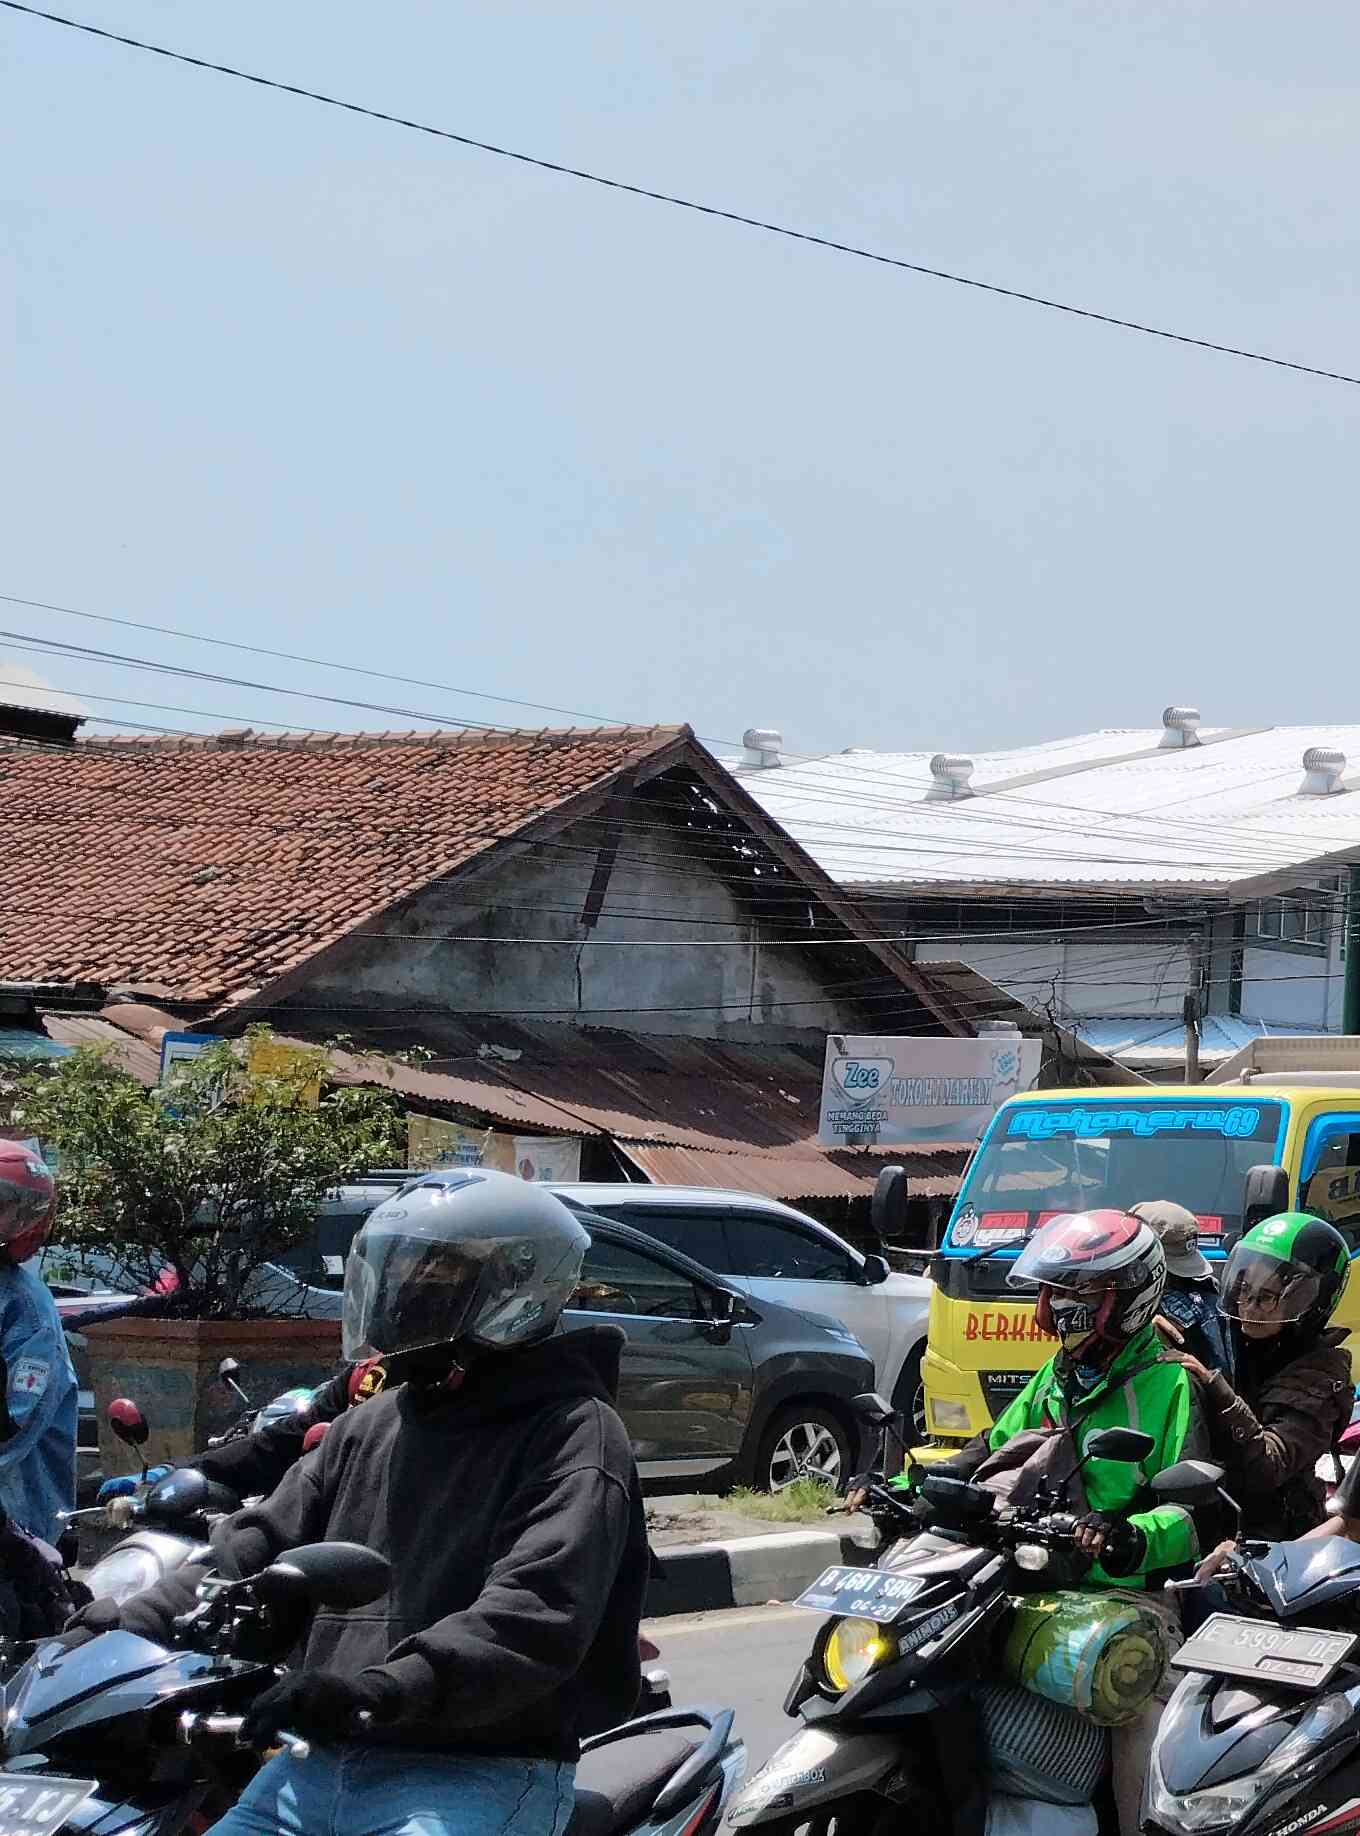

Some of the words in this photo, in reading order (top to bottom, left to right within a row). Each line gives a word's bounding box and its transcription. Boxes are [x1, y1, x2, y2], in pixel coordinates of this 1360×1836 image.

[844, 1062, 880, 1089] Zee
[827, 1111, 864, 1122] MEMANG
[865, 1111, 888, 1122] BEDA
[965, 1312, 1060, 1342] BERKA
[820, 1569, 839, 1587] B
[1277, 1803, 1328, 1836] HONDA
